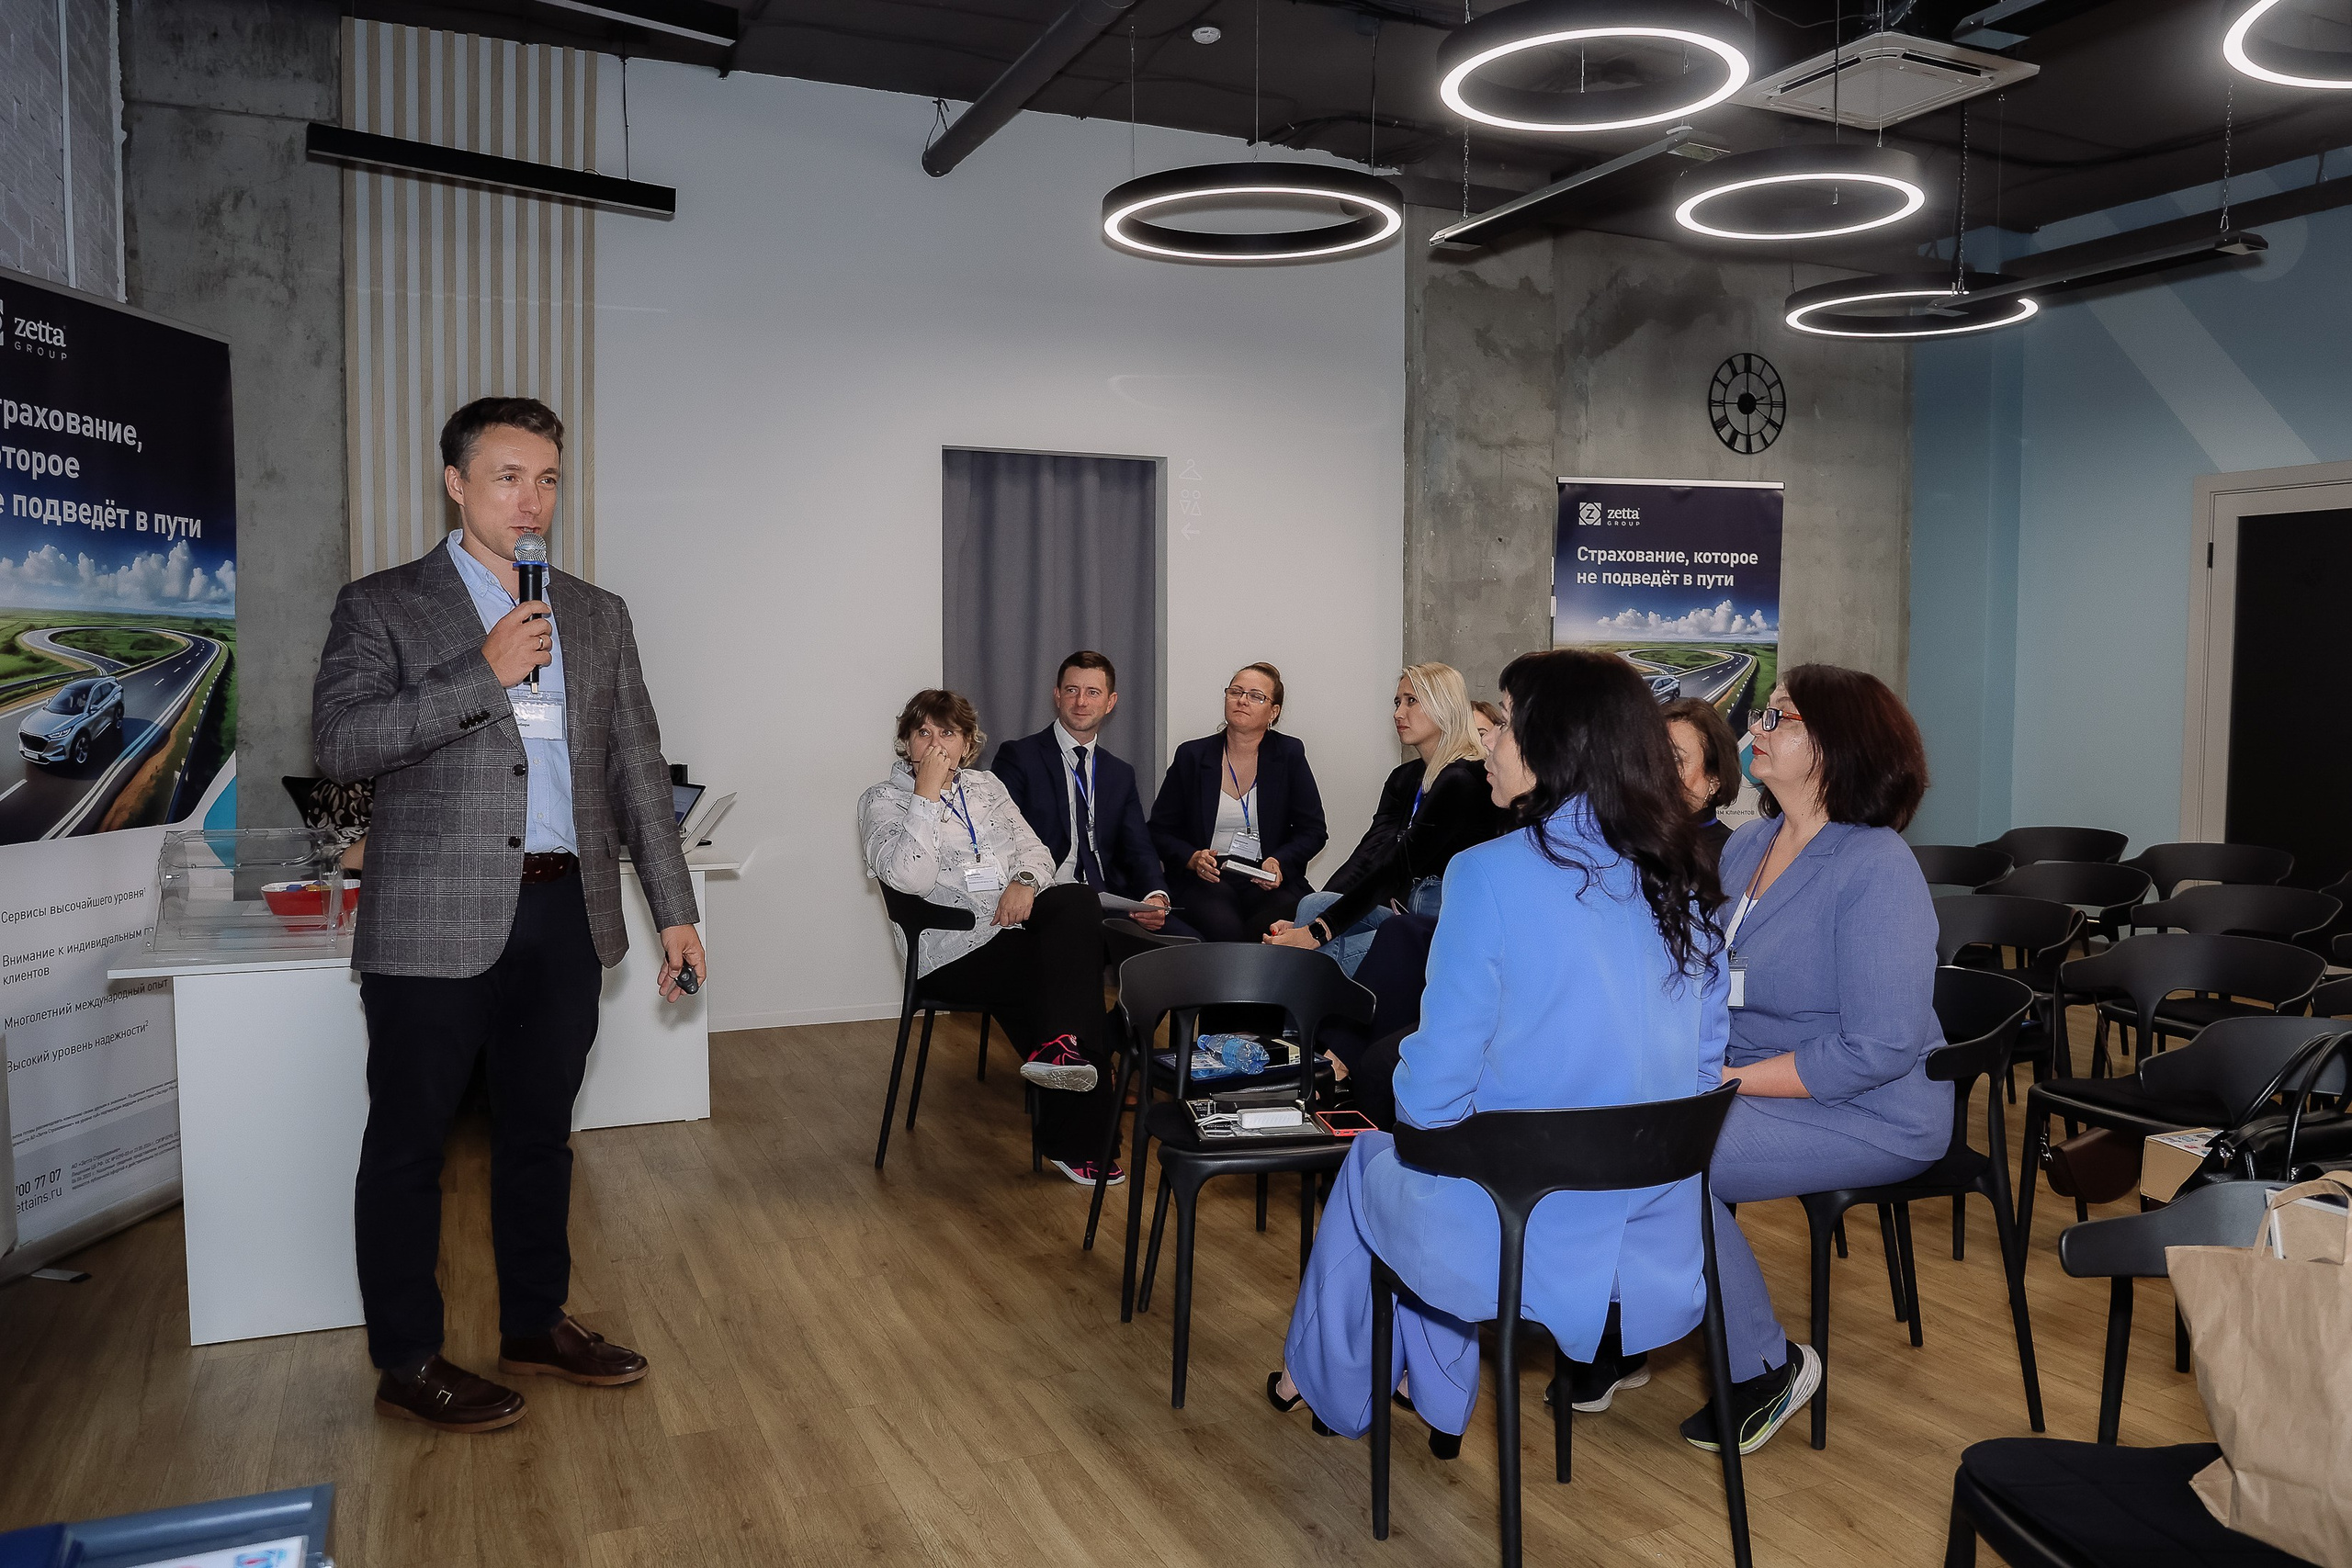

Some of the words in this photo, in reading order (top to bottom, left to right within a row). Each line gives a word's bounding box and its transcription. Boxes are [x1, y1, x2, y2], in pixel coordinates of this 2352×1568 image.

[14, 317, 67, 347] zetta
[14, 341, 67, 361] GROUP
[0, 398, 142, 453] рахование,
[0, 446, 80, 480] торое
[13, 493, 130, 531] подведёт
[136, 511, 148, 531] в
[154, 513, 202, 541] пути
[1607, 508, 1640, 520] zetta
[1577, 546, 1690, 566] Страхование,
[1694, 551, 1758, 568] которое
[1577, 571, 1598, 584] не
[1602, 570, 1679, 587] подведёт
[1683, 573, 1692, 585] в
[1697, 573, 1735, 590] пути
[1, 908, 47, 924] Сервисы
[50, 895, 112, 915] высочайшего
[3, 948, 55, 967] Внимание
[58, 945, 64, 956] к
[67, 929, 142, 954] индивидуальным
[3, 966, 50, 986] клиентов
[5, 1002, 73, 1030] Многолетний
[75, 983, 145, 1012] международный
[147, 979, 168, 993] опыт
[7, 1050, 50, 1073] Высокий
[51, 1041, 93, 1062] уровень
[35, 1175, 46, 1190] 77
[50, 1168, 62, 1183] 07
